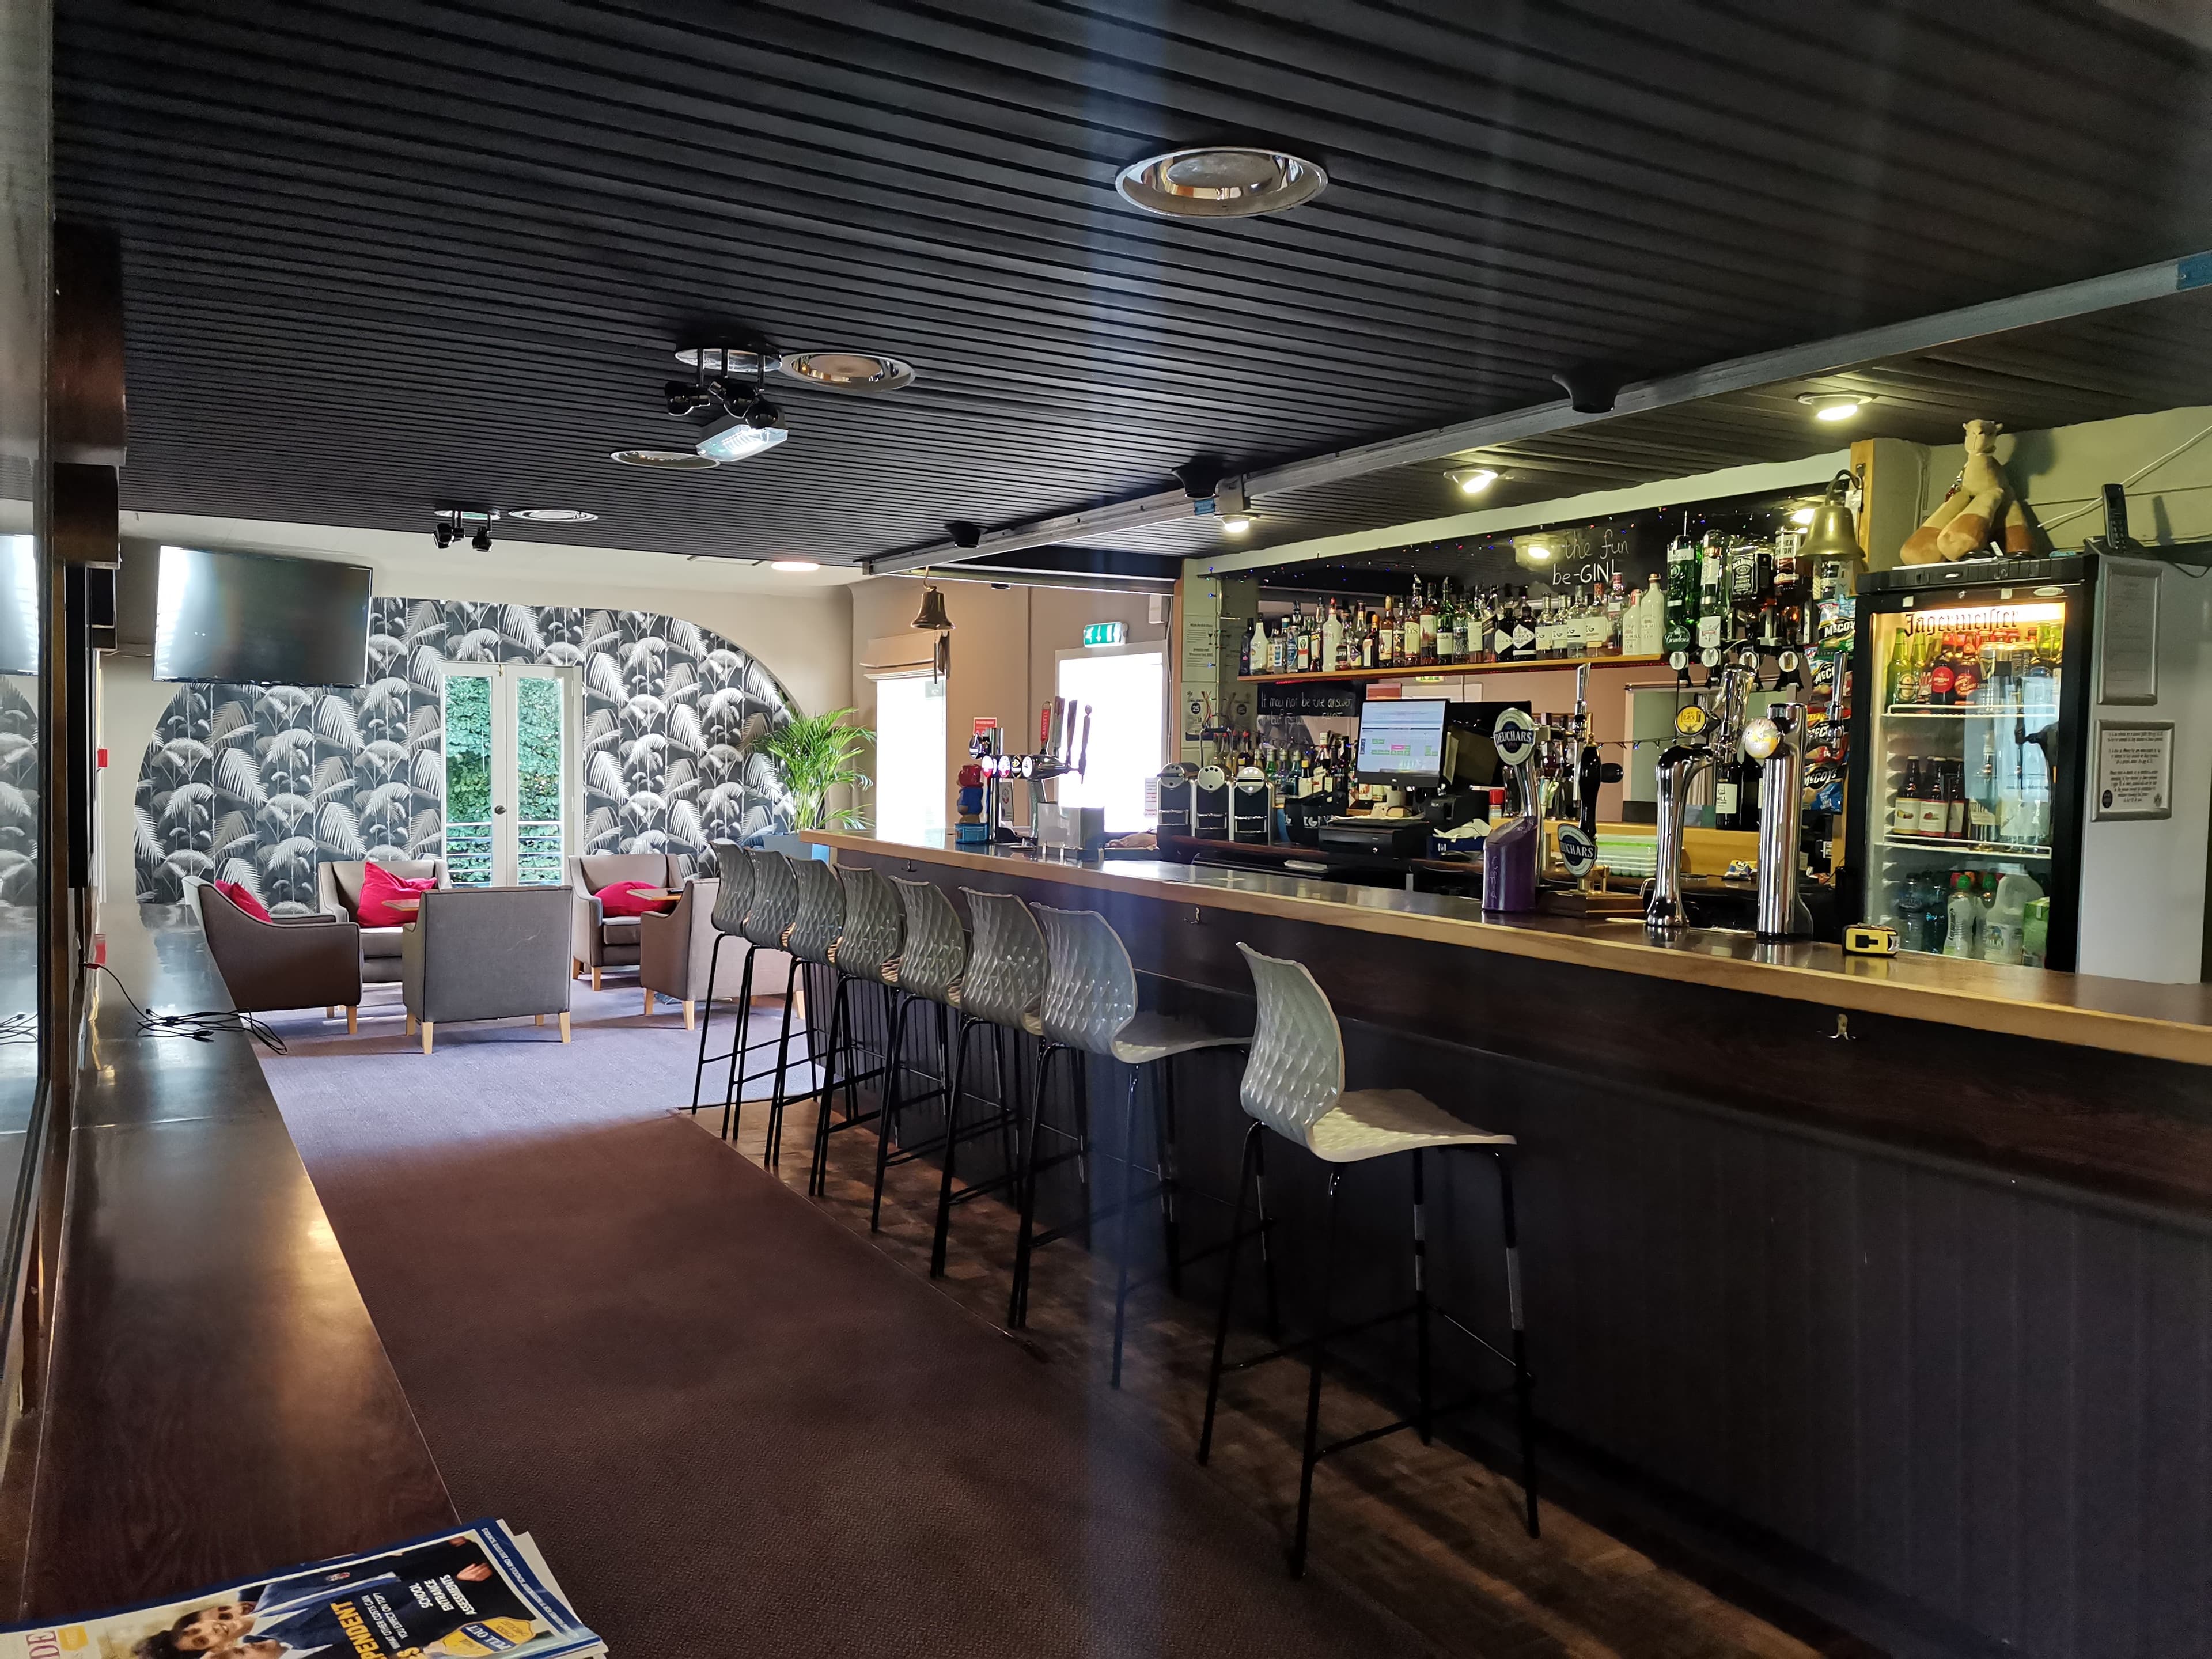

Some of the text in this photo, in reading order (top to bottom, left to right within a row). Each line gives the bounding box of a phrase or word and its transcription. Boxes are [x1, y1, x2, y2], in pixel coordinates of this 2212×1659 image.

[1562, 529, 1629, 559] the fun
[1495, 730, 1532, 744] DEUCHARS
[361, 1594, 373, 1606] CAN
[409, 1582, 433, 1608] SCHOOL
[424, 1579, 454, 1611] ENTRANCE
[440, 1574, 478, 1615] ASSESSMENTS
[368, 1605, 382, 1621] COSTS
[381, 1605, 392, 1613] ON
[376, 1621, 392, 1637] OTHER
[465, 1624, 488, 1638] OUT
[486, 1635, 512, 1650] PULL
